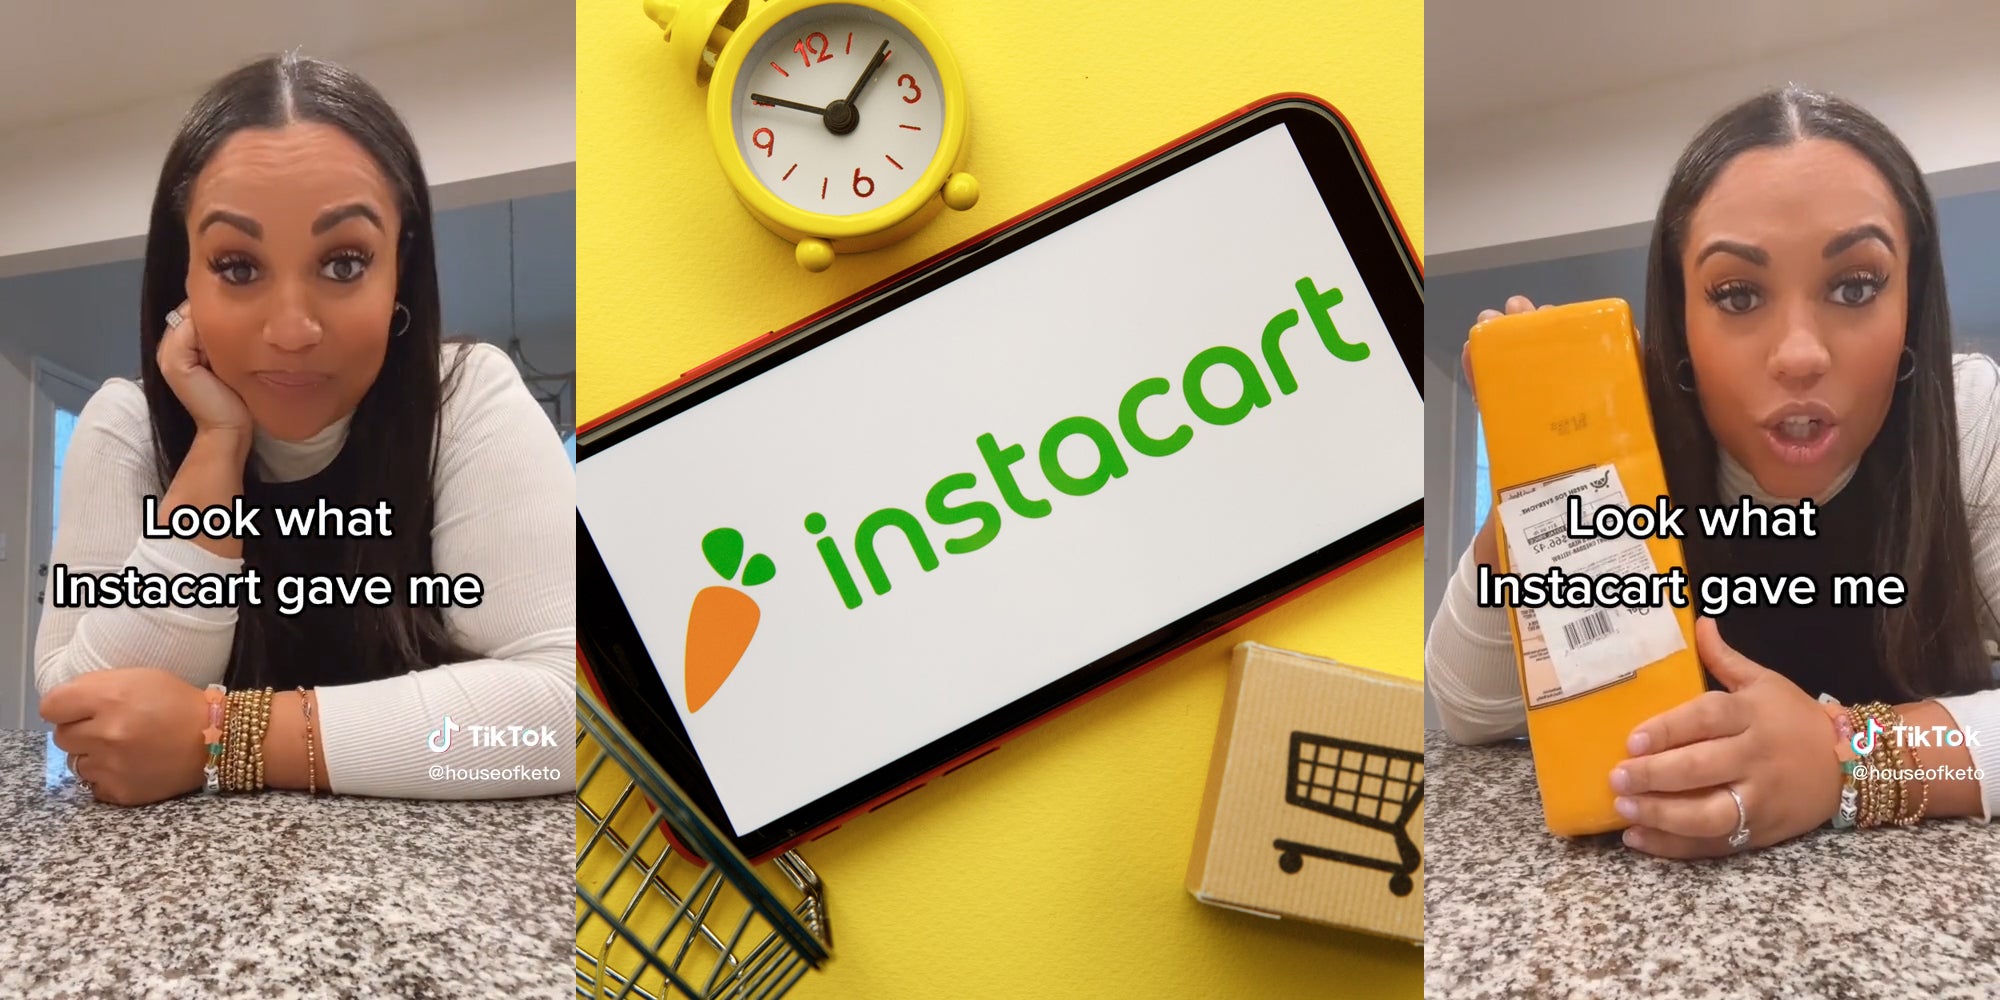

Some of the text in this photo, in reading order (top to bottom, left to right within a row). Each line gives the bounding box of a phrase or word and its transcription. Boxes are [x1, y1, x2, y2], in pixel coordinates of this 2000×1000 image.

[793, 32, 833, 67] 12
[897, 73, 922, 104] 3
[752, 127, 775, 158] 9
[852, 167, 875, 198] 6
[804, 276, 1371, 610] instacart
